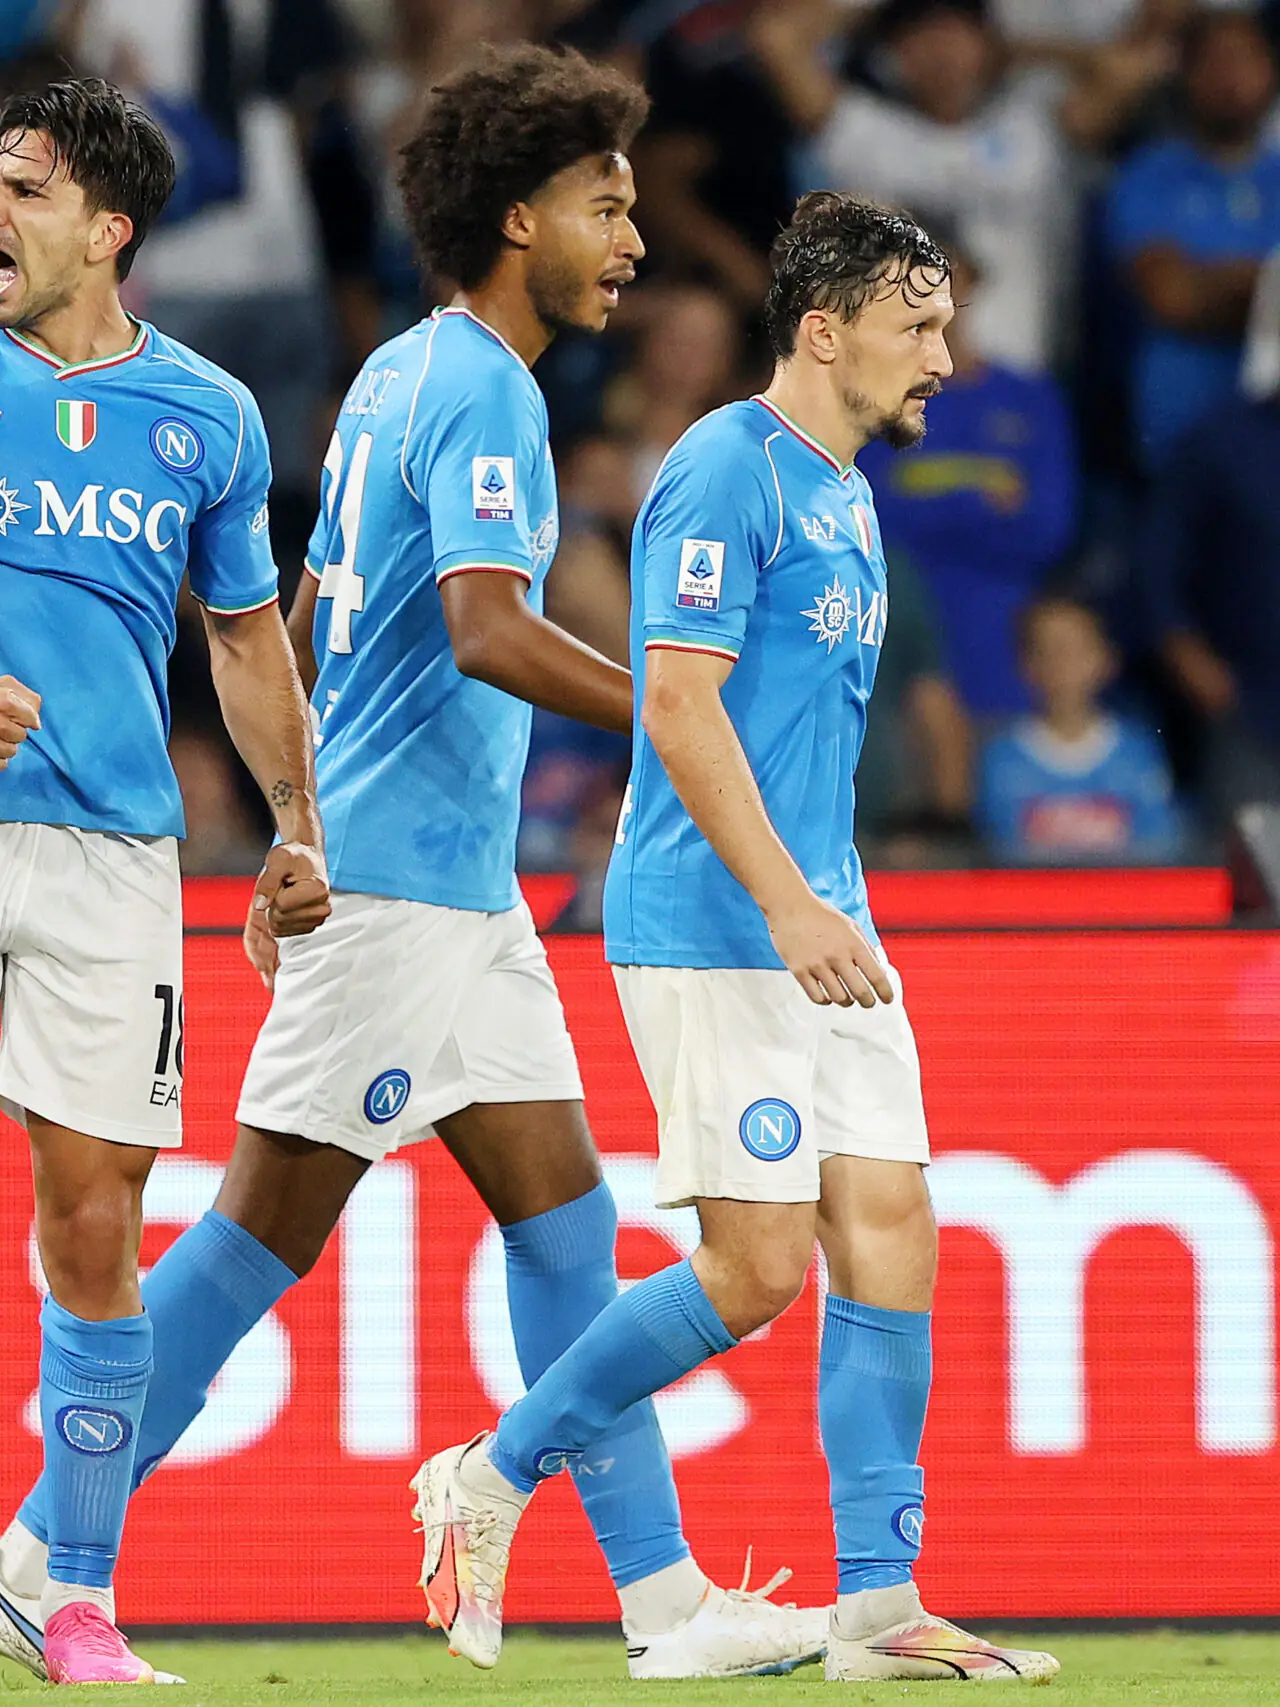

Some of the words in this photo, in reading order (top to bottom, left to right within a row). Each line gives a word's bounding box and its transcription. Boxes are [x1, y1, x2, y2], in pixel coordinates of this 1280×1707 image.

[164, 429, 189, 461] N
[33, 480, 187, 553] MSC
[490, 510, 509, 519] TIM
[799, 514, 837, 541] EA7
[684, 581, 706, 590] SERIE
[693, 596, 714, 609] TIM
[154, 984, 183, 1079] 1
[149, 1080, 183, 1109] EA
[376, 1083, 404, 1111] N
[757, 1115, 785, 1144] N
[74, 1417, 107, 1445] N
